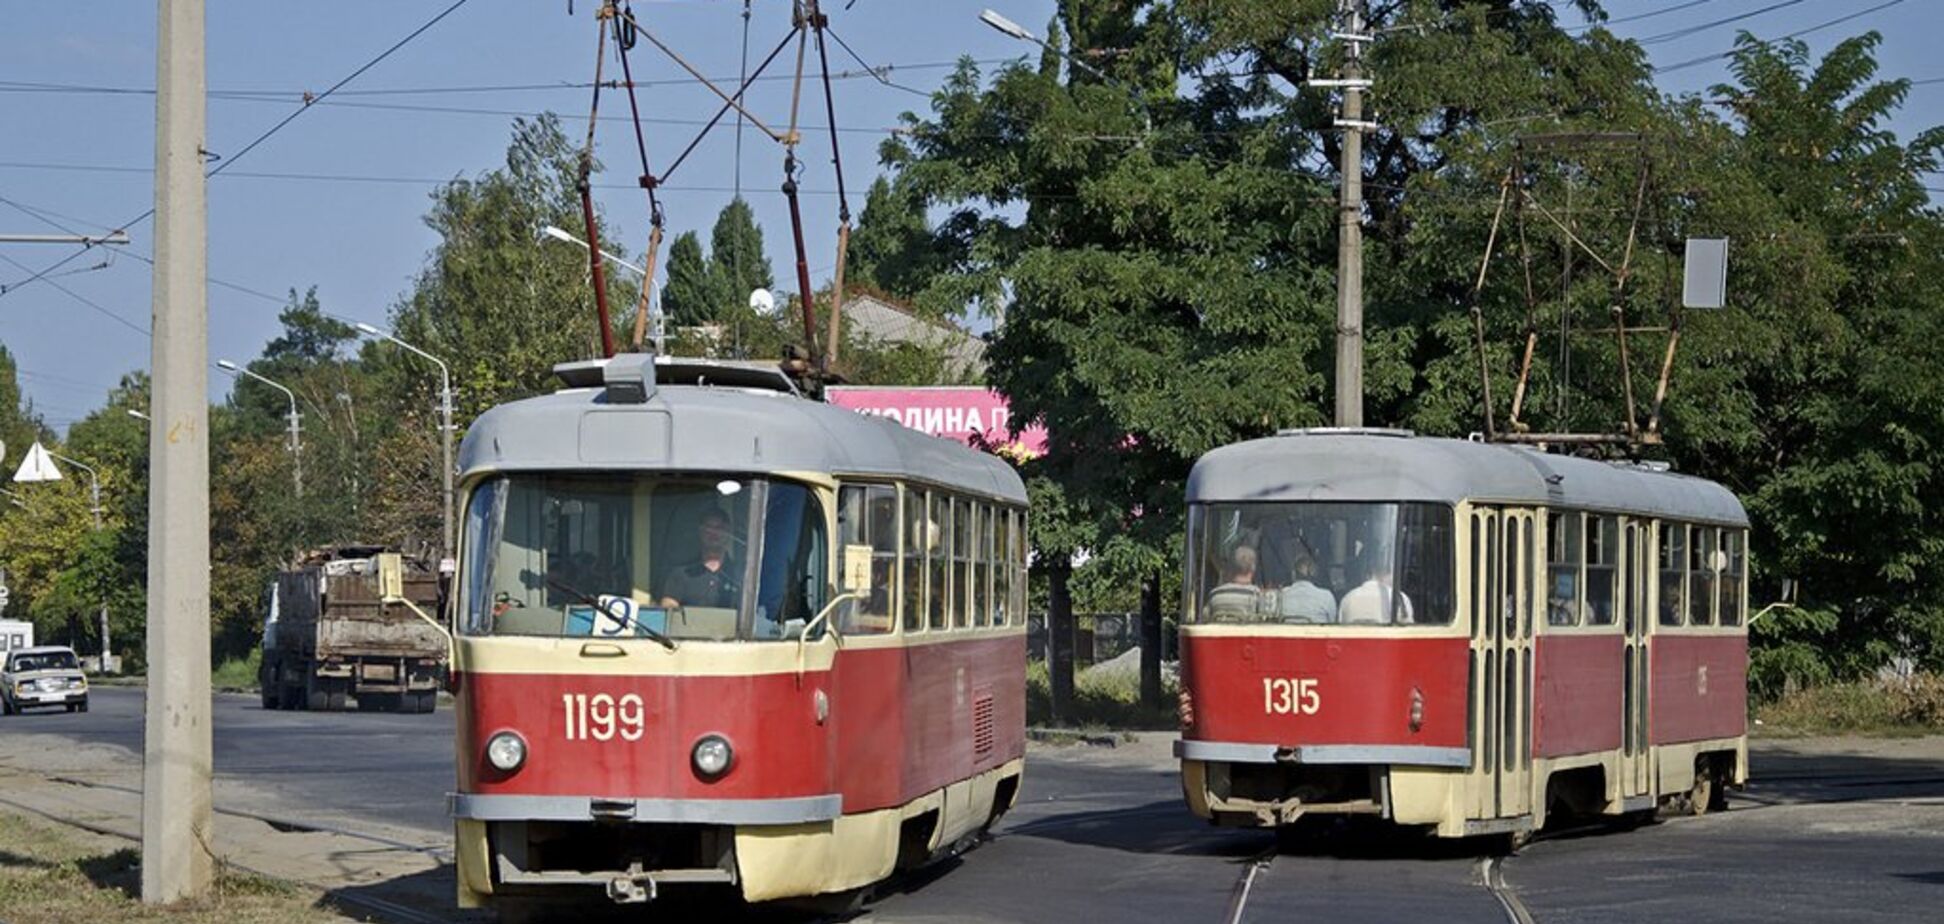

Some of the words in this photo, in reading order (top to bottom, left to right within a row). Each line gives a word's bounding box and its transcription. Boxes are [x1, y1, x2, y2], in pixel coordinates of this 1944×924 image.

[601, 597, 631, 635] 9
[1263, 678, 1320, 715] 1315
[562, 693, 645, 741] 1199
